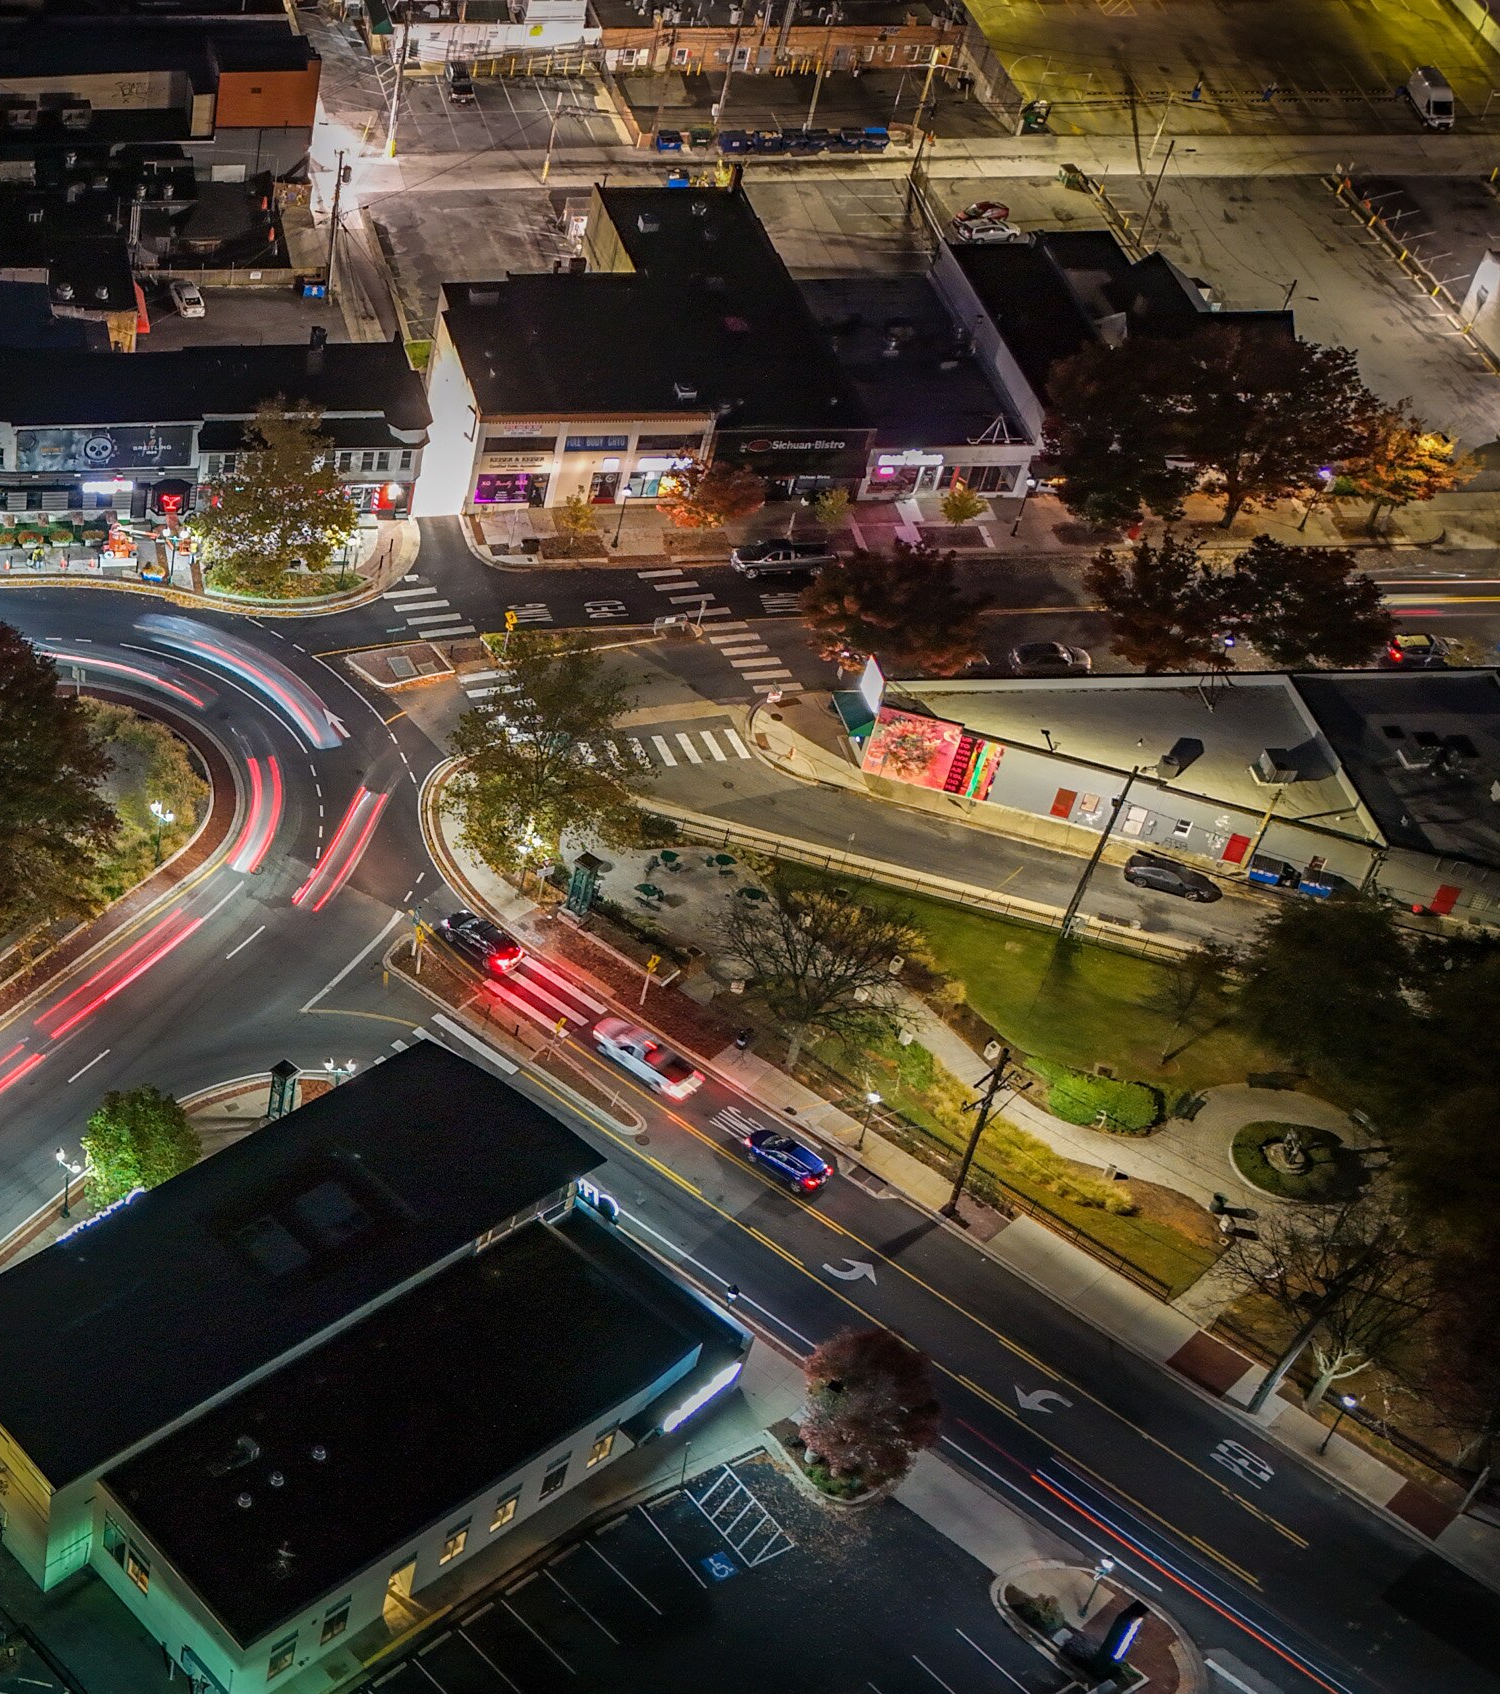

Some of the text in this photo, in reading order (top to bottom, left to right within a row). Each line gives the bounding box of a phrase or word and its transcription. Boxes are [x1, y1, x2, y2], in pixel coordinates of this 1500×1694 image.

[814, 440, 845, 450] Bistro
[583, 600, 629, 619] PED
[1210, 1439, 1275, 1489] PED
